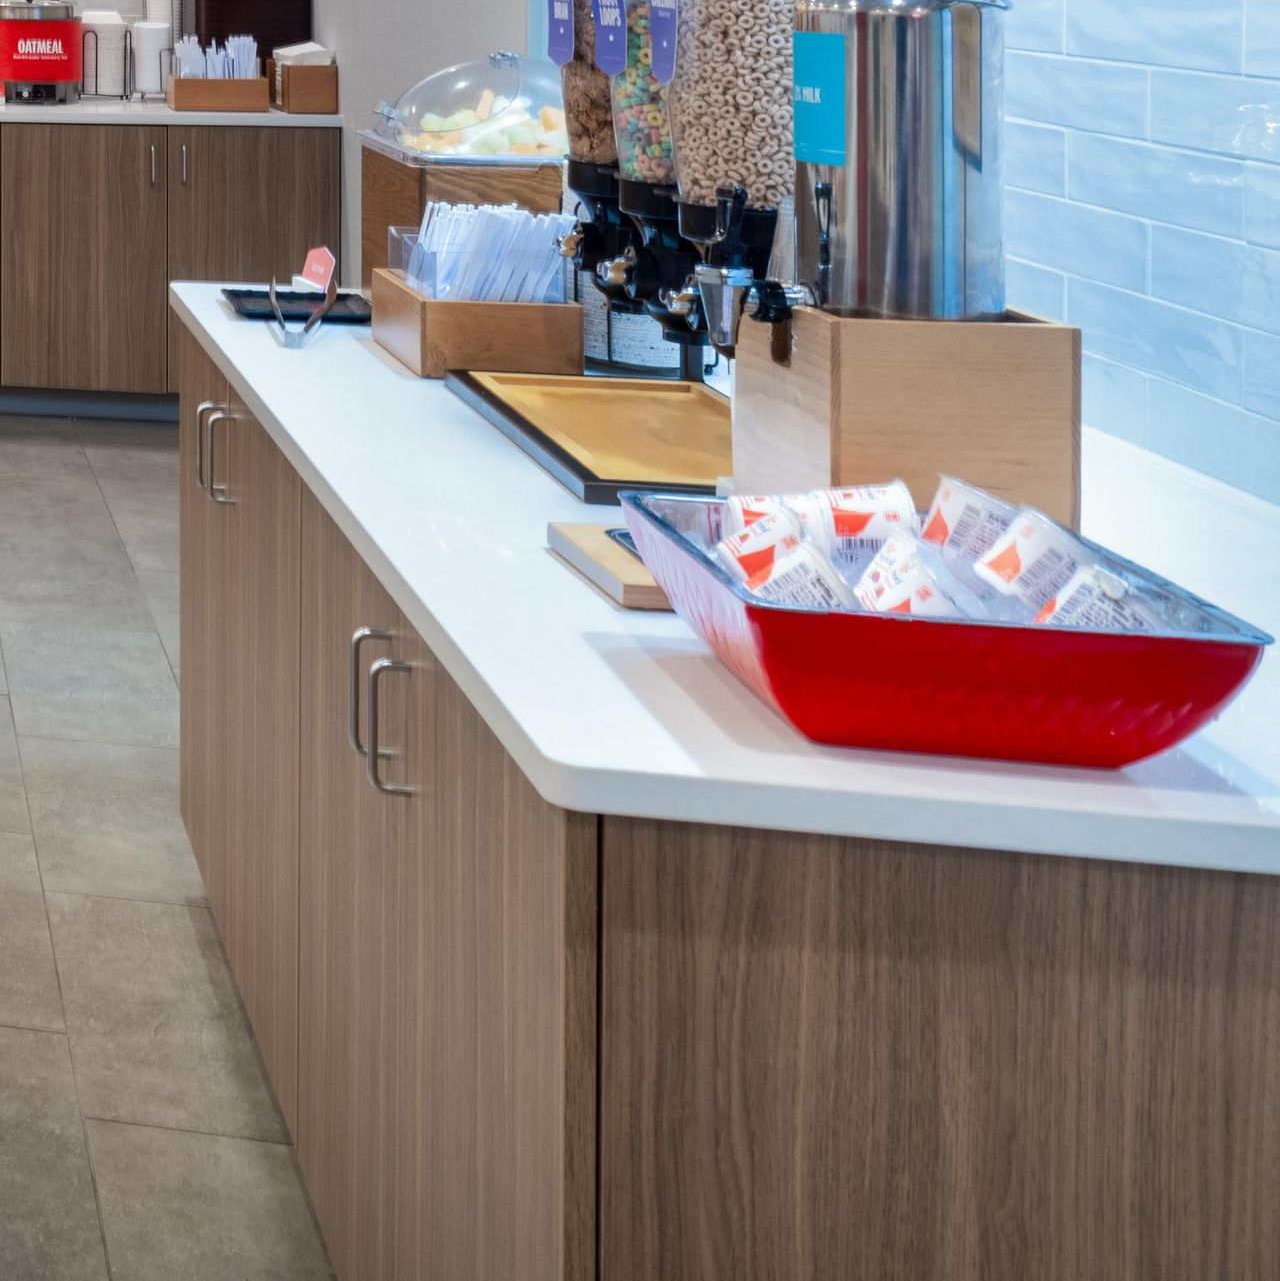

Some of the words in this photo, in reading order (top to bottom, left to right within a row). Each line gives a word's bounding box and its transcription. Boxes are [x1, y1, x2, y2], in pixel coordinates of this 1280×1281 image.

[599, 5, 622, 27] LOOPS
[17, 37, 64, 55] OATMEAL
[802, 86, 822, 104] MILK
